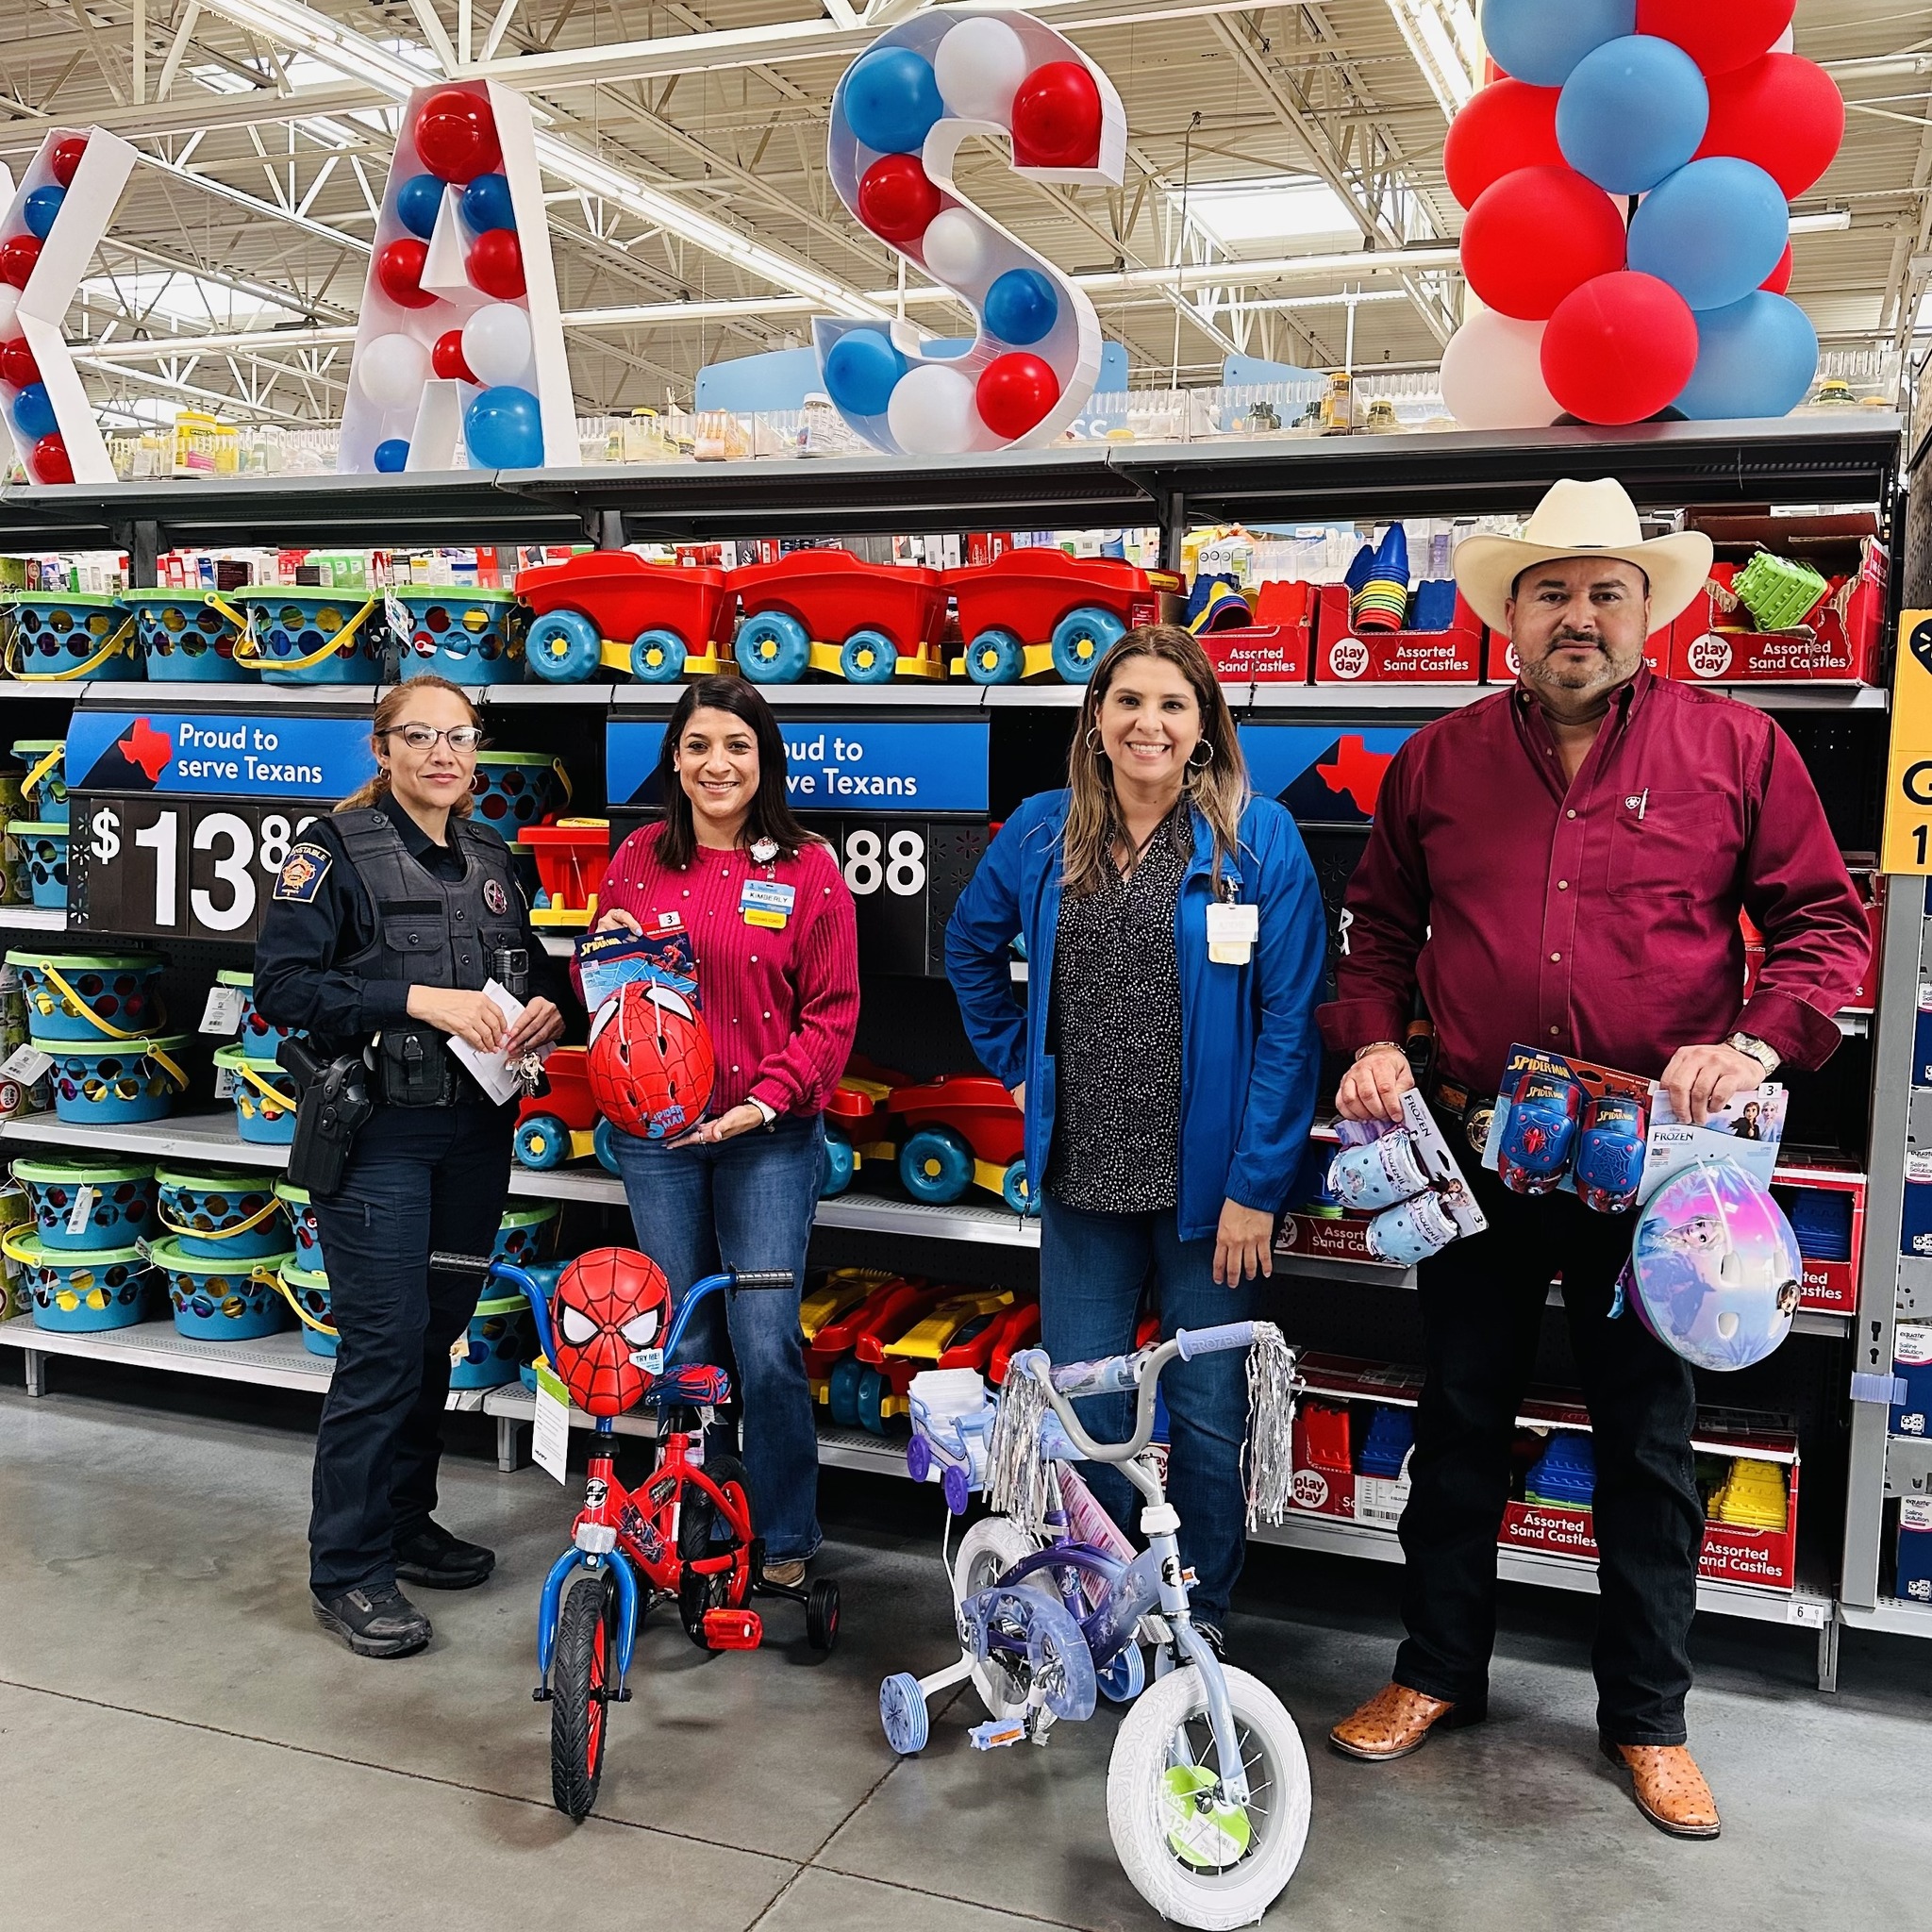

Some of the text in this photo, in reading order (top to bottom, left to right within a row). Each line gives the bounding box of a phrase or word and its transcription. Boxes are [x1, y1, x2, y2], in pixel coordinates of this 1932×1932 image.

[1229, 646, 1284, 659] Assorted
[1334, 645, 1365, 664] play
[1396, 644, 1456, 658] Assorted
[1692, 643, 1728, 661] play
[1763, 641, 1832, 655] Assorted
[1217, 659, 1248, 673] Sand
[1336, 658, 1362, 674] day
[1383, 658, 1469, 672] Sand Castles
[1695, 657, 1724, 672] day
[1748, 656, 1846, 669] Sand Castles
[179, 723, 278, 751] Proud to
[834, 738, 863, 761] to
[178, 756, 323, 784] serve Texans
[823, 767, 918, 796] Texans
[749, 891, 789, 903] KIMBERLY
[1507, 1055, 1571, 1079] SPIDER-MAN
[1404, 1094, 1432, 1138] FROZEN
[1654, 1132, 1694, 1141] FROZEN
[1324, 1226, 1366, 1241] Assort
[1312, 1238, 1344, 1250] Sand
[1800, 1286, 1842, 1300] astles
[636, 1355, 647, 1363] TRY
[1293, 1475, 1324, 1492] play
[1295, 1488, 1322, 1505] day
[1524, 1512, 1584, 1533] Assorted
[1509, 1524, 1597, 1548] Sand Castles
[1705, 1541, 1769, 1561] Assorted
[1699, 1556, 1783, 1577] and Castles
[1797, 1606, 1804, 1618] 6
